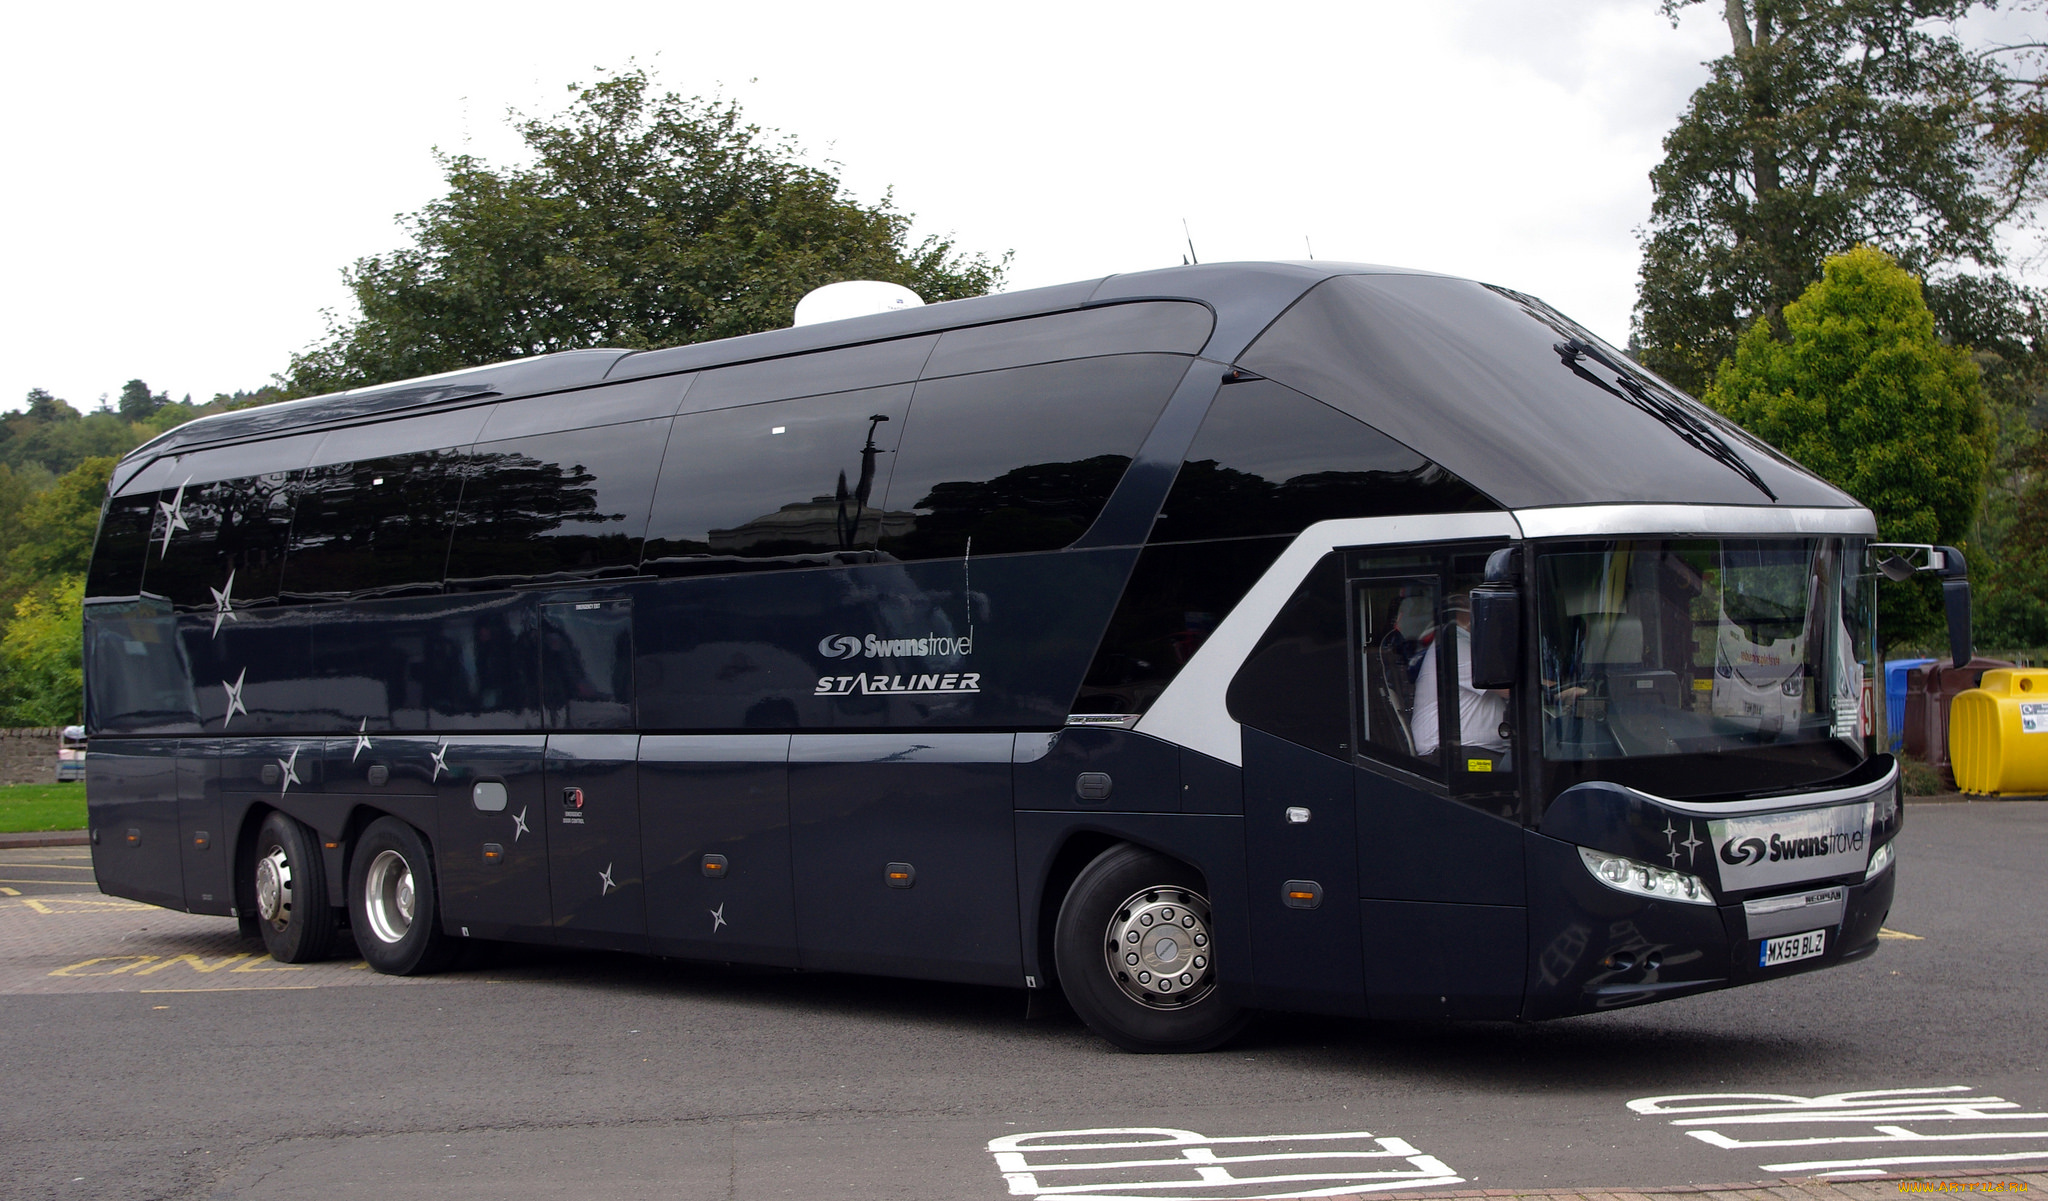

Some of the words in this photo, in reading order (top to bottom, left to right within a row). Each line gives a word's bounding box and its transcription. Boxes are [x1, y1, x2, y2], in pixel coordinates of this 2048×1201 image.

[864, 625, 974, 658] Swanstravel
[814, 672, 981, 695] STARLINER
[1769, 815, 1864, 863] Swanstravel
[1768, 938, 1800, 962] MX59
[1801, 933, 1824, 956] BLZ
[48, 953, 370, 977] ONL
